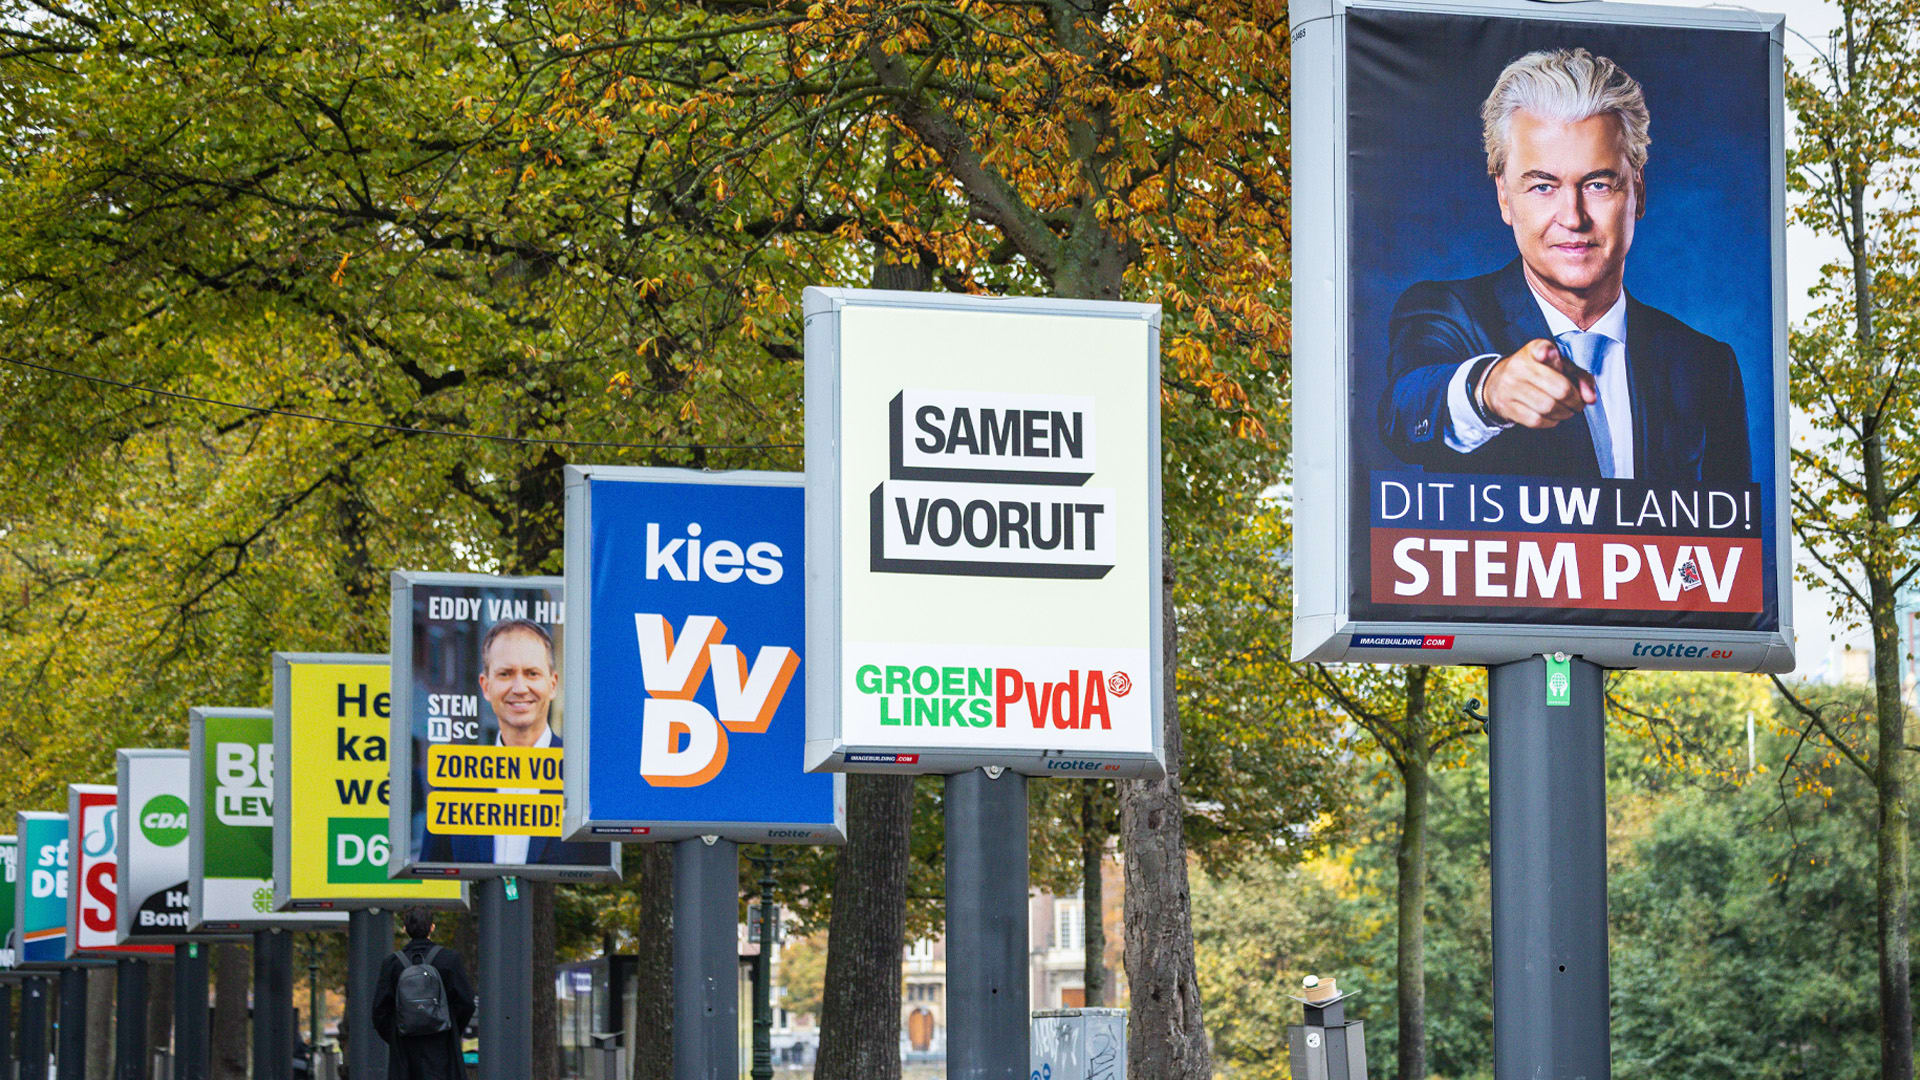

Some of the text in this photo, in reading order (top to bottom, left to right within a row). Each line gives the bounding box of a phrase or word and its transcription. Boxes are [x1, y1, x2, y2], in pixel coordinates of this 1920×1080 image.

[915, 405, 1083, 459] SAMEN
[1381, 481, 1751, 531] DIT IS UW LAND!
[896, 497, 1105, 551] VOORUIT
[646, 522, 784, 585] kies
[1392, 537, 1744, 604] STEM PVV
[429, 596, 481, 621] EDDY
[488, 598, 528, 622] VAN
[856, 664, 993, 697] GROEN
[428, 693, 478, 717] STEM
[880, 697, 993, 729] LINKS
[996, 668, 1112, 730] PvdA
[337, 727, 387, 762] ka
[436, 755, 520, 779] ZORGEN
[144, 813, 188, 829] CDA
[436, 801, 560, 828] ZEKERHEID!
[337, 833, 390, 867] D6
